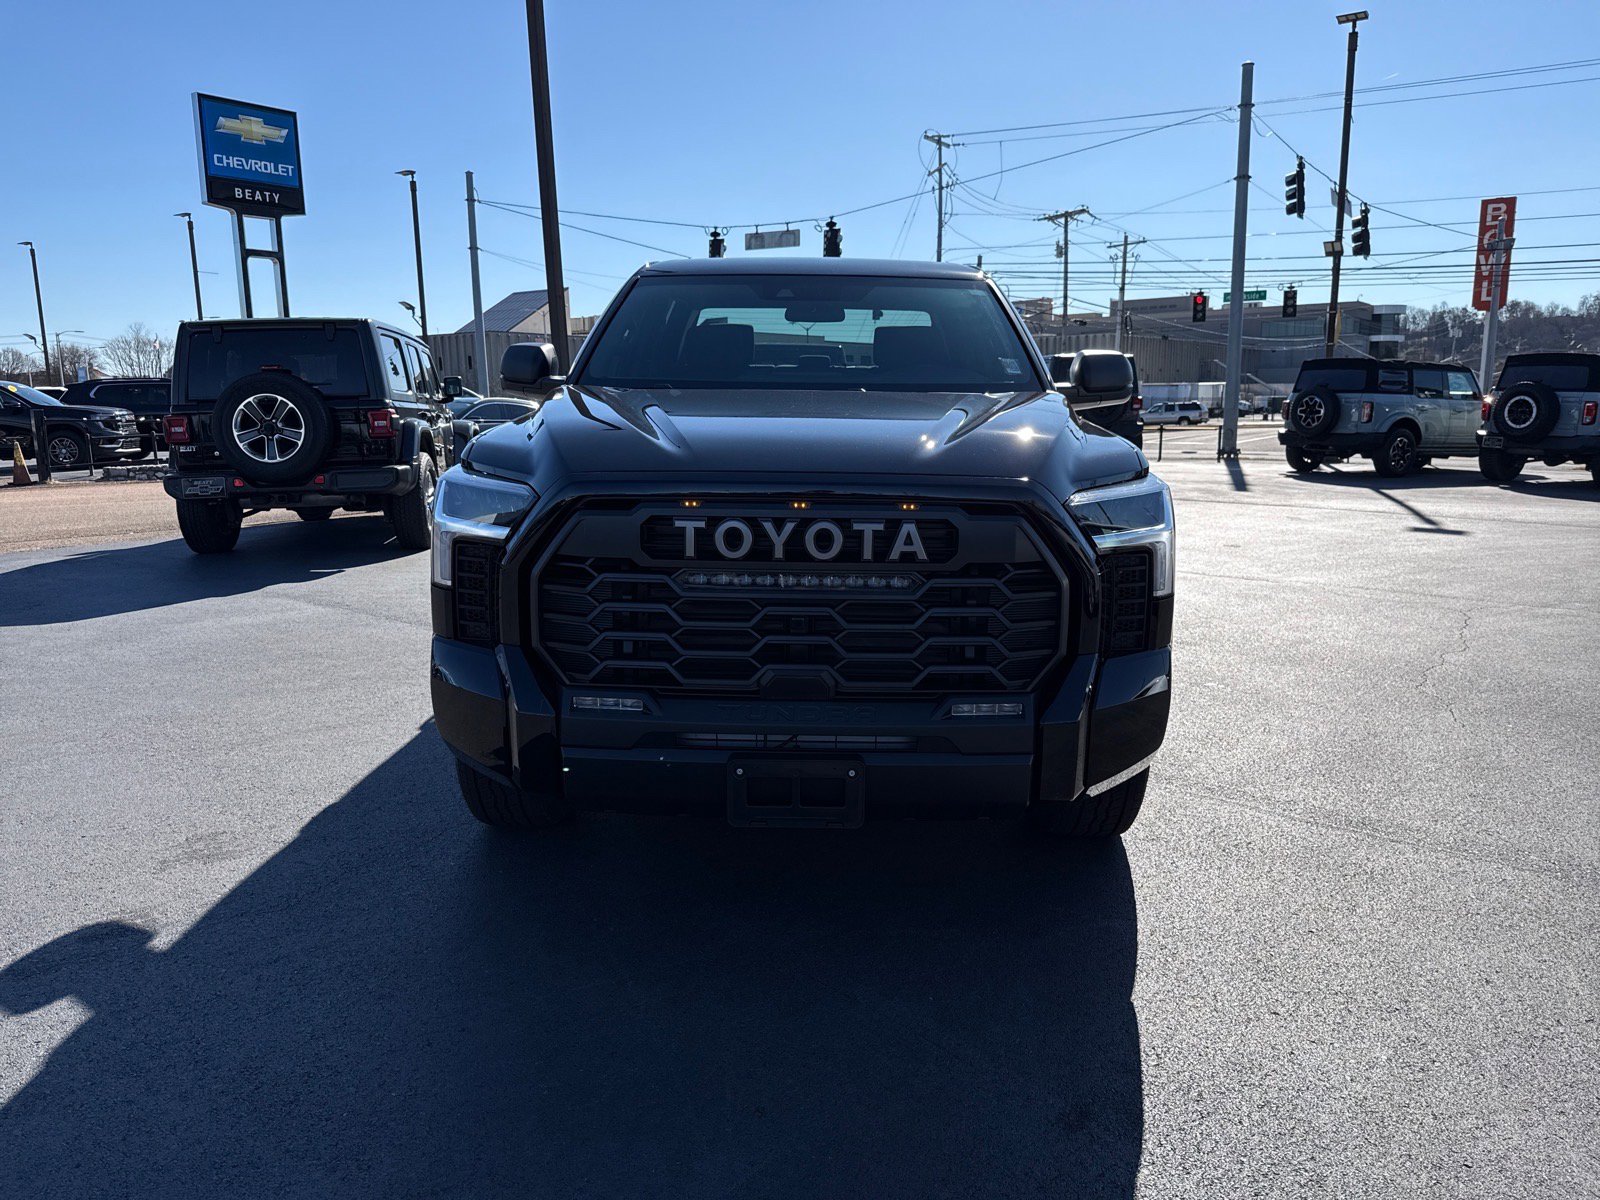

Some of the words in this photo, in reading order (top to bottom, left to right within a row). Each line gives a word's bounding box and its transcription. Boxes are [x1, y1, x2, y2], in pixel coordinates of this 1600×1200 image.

[213, 153, 294, 177] CHEVROLET
[234, 187, 280, 204] BEATY
[674, 519, 928, 561] TOYOTA
